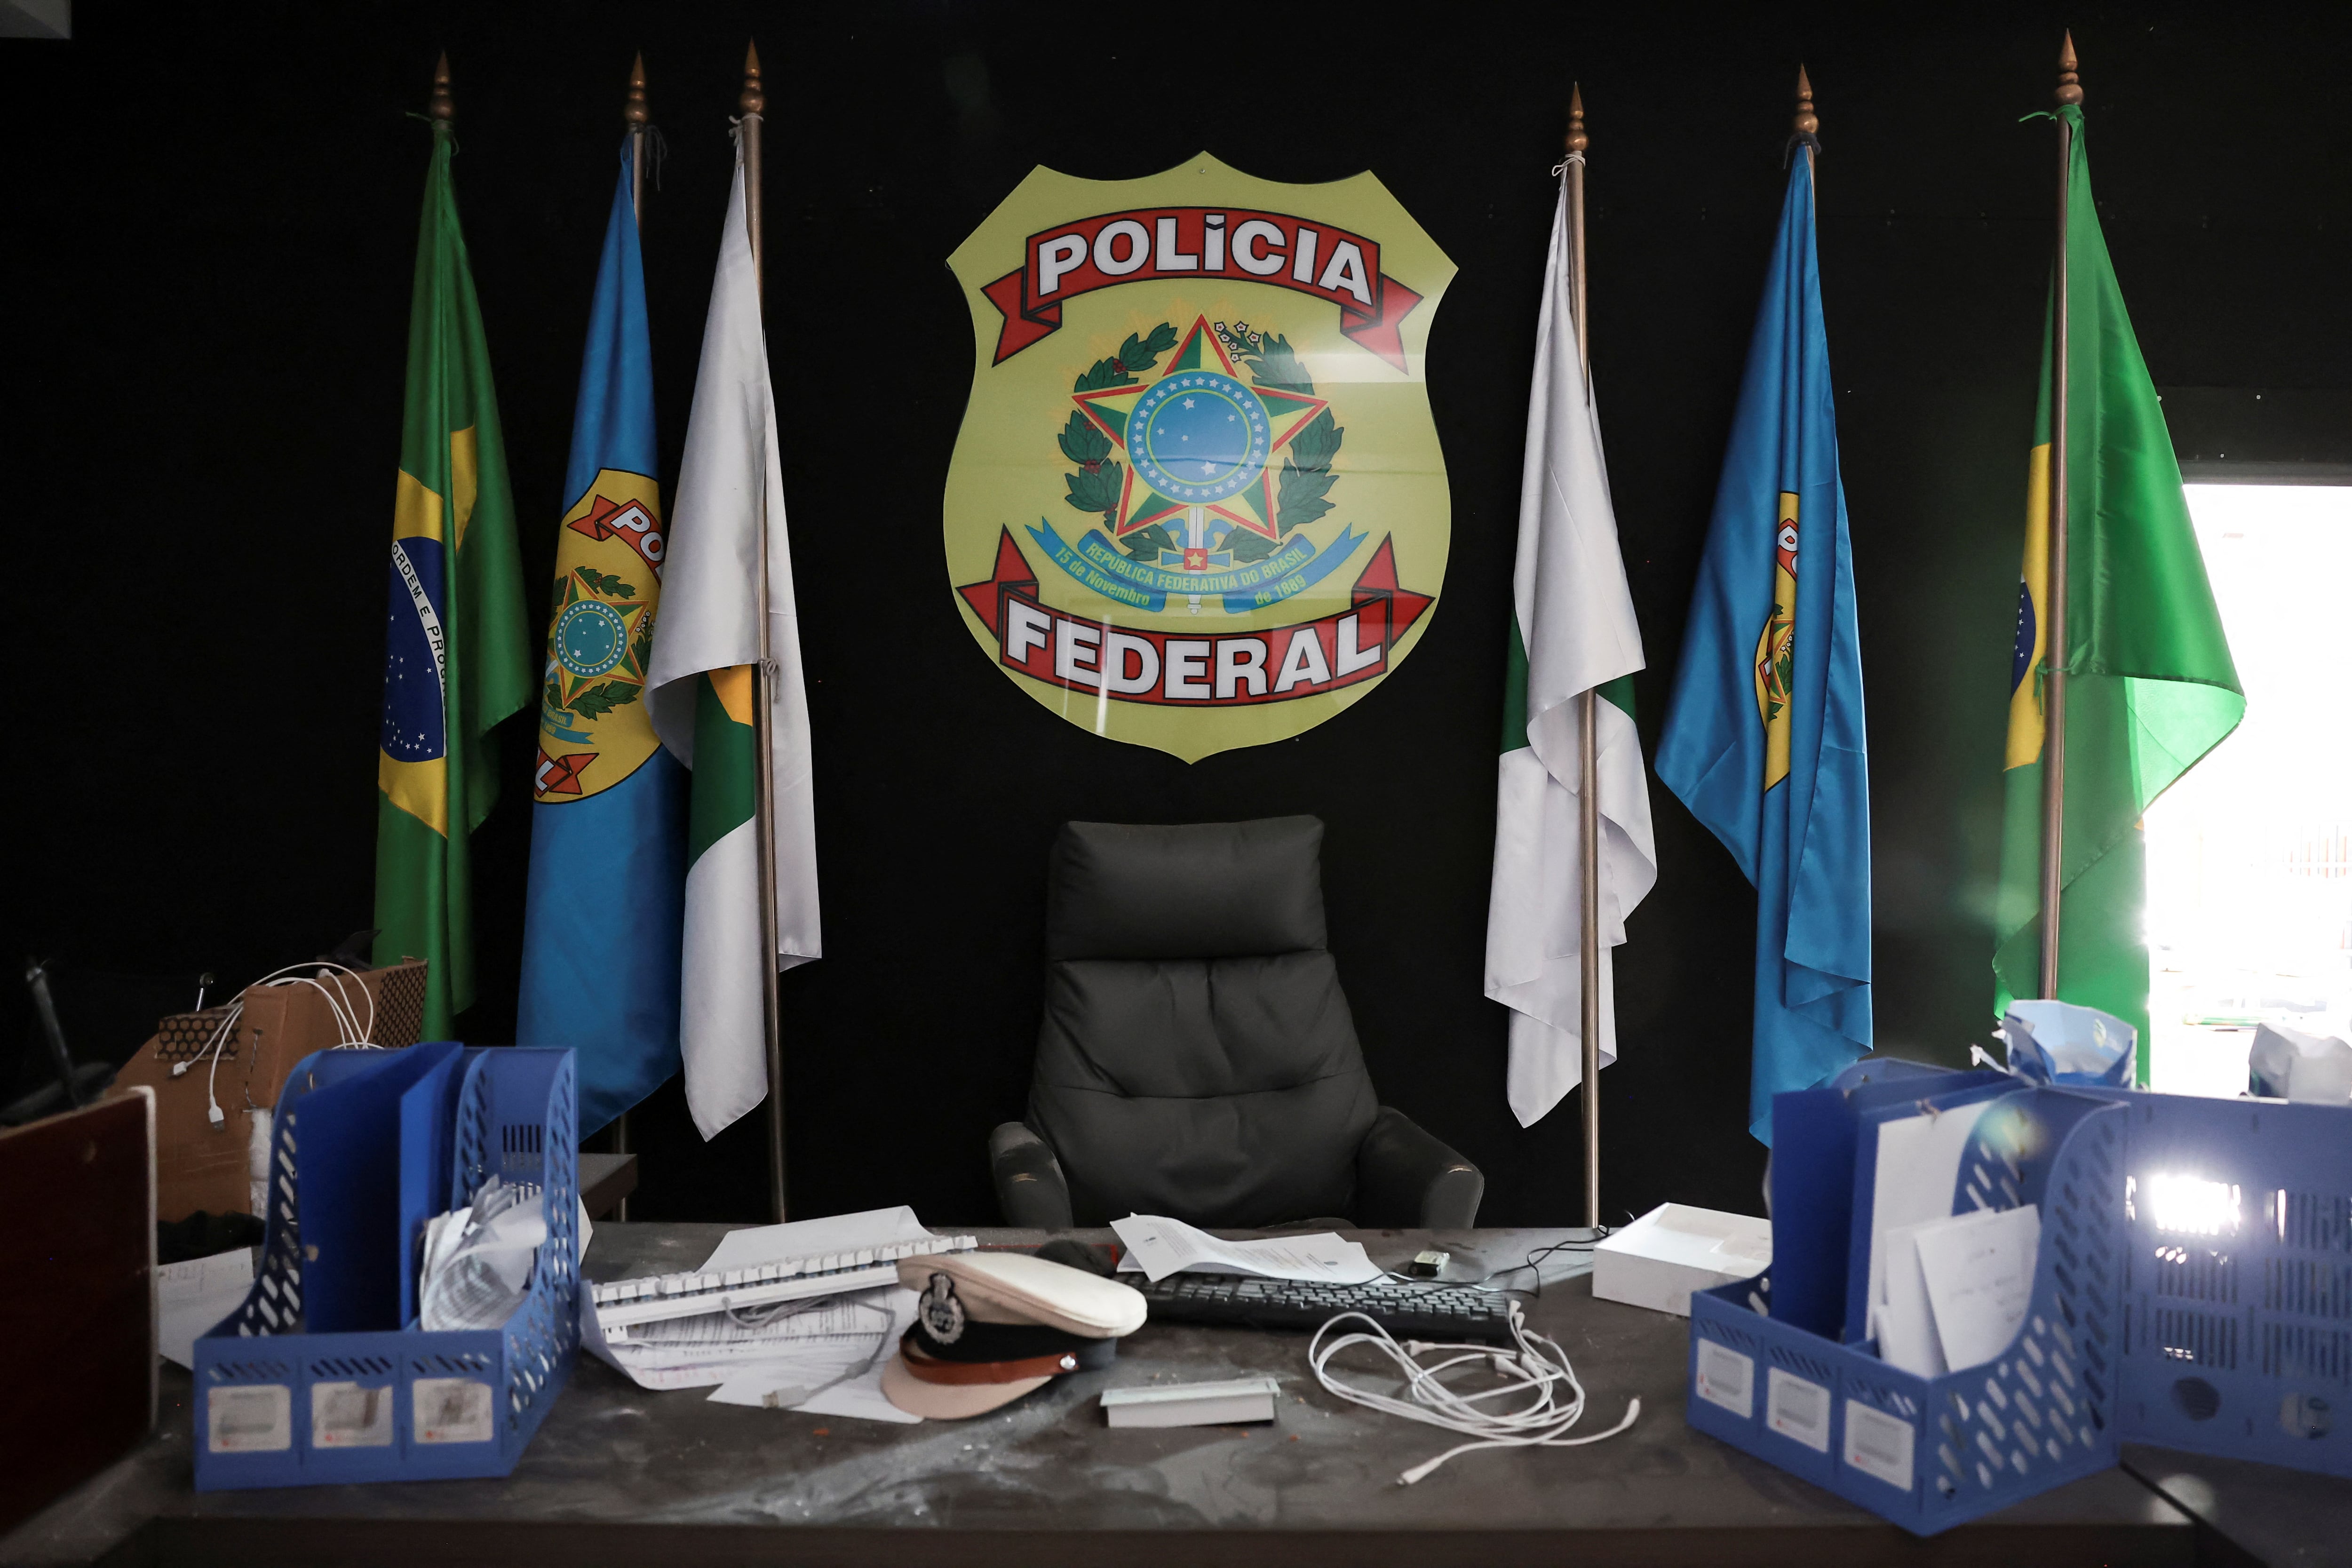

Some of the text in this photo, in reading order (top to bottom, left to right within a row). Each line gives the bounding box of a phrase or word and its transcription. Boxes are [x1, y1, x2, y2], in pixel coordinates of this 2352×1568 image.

[393, 545, 422, 599] ORDEM
[420, 605, 430, 617] E
[1055, 547, 1150, 605] 15 de Novembro
[1086, 542, 1307, 592] REPÚBLICA FEDERATIVA DO BRASIL
[1255, 574, 1306, 605] de 1889
[1007, 598, 1382, 700] FEDERAL
